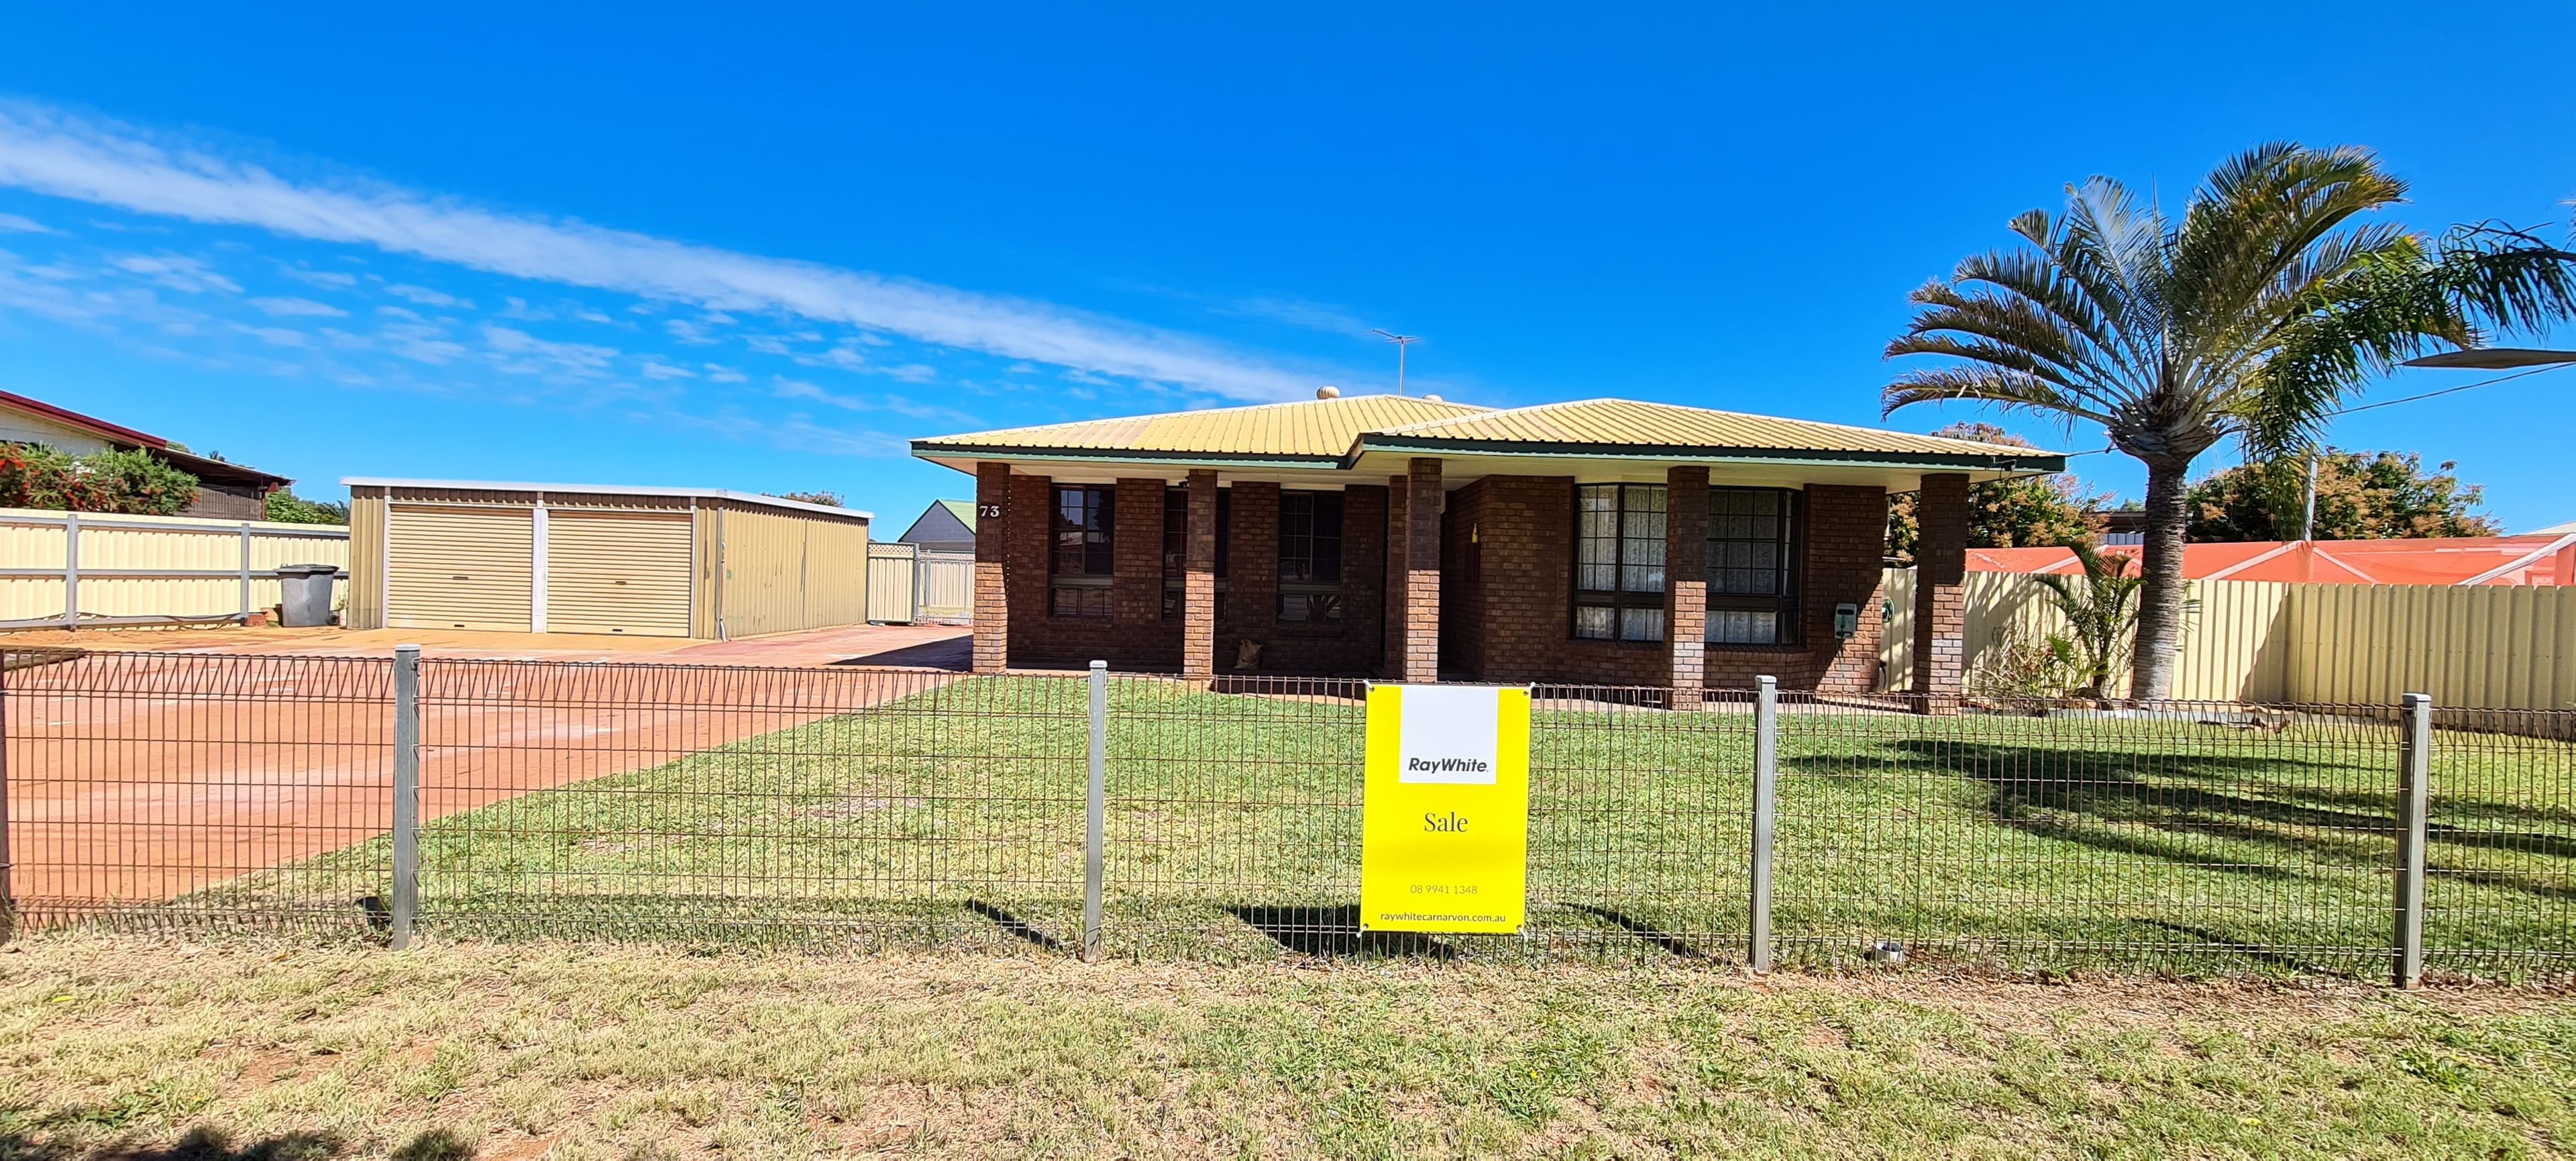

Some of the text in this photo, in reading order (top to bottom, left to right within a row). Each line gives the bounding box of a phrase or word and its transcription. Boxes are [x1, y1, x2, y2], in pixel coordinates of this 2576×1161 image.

[979, 505, 1000, 517] 73
[1424, 811, 1468, 833] Sale
[1410, 885, 1478, 895] 08 9941 1348
[1380, 912, 1506, 923] raywhitecarnarvon.com.au
